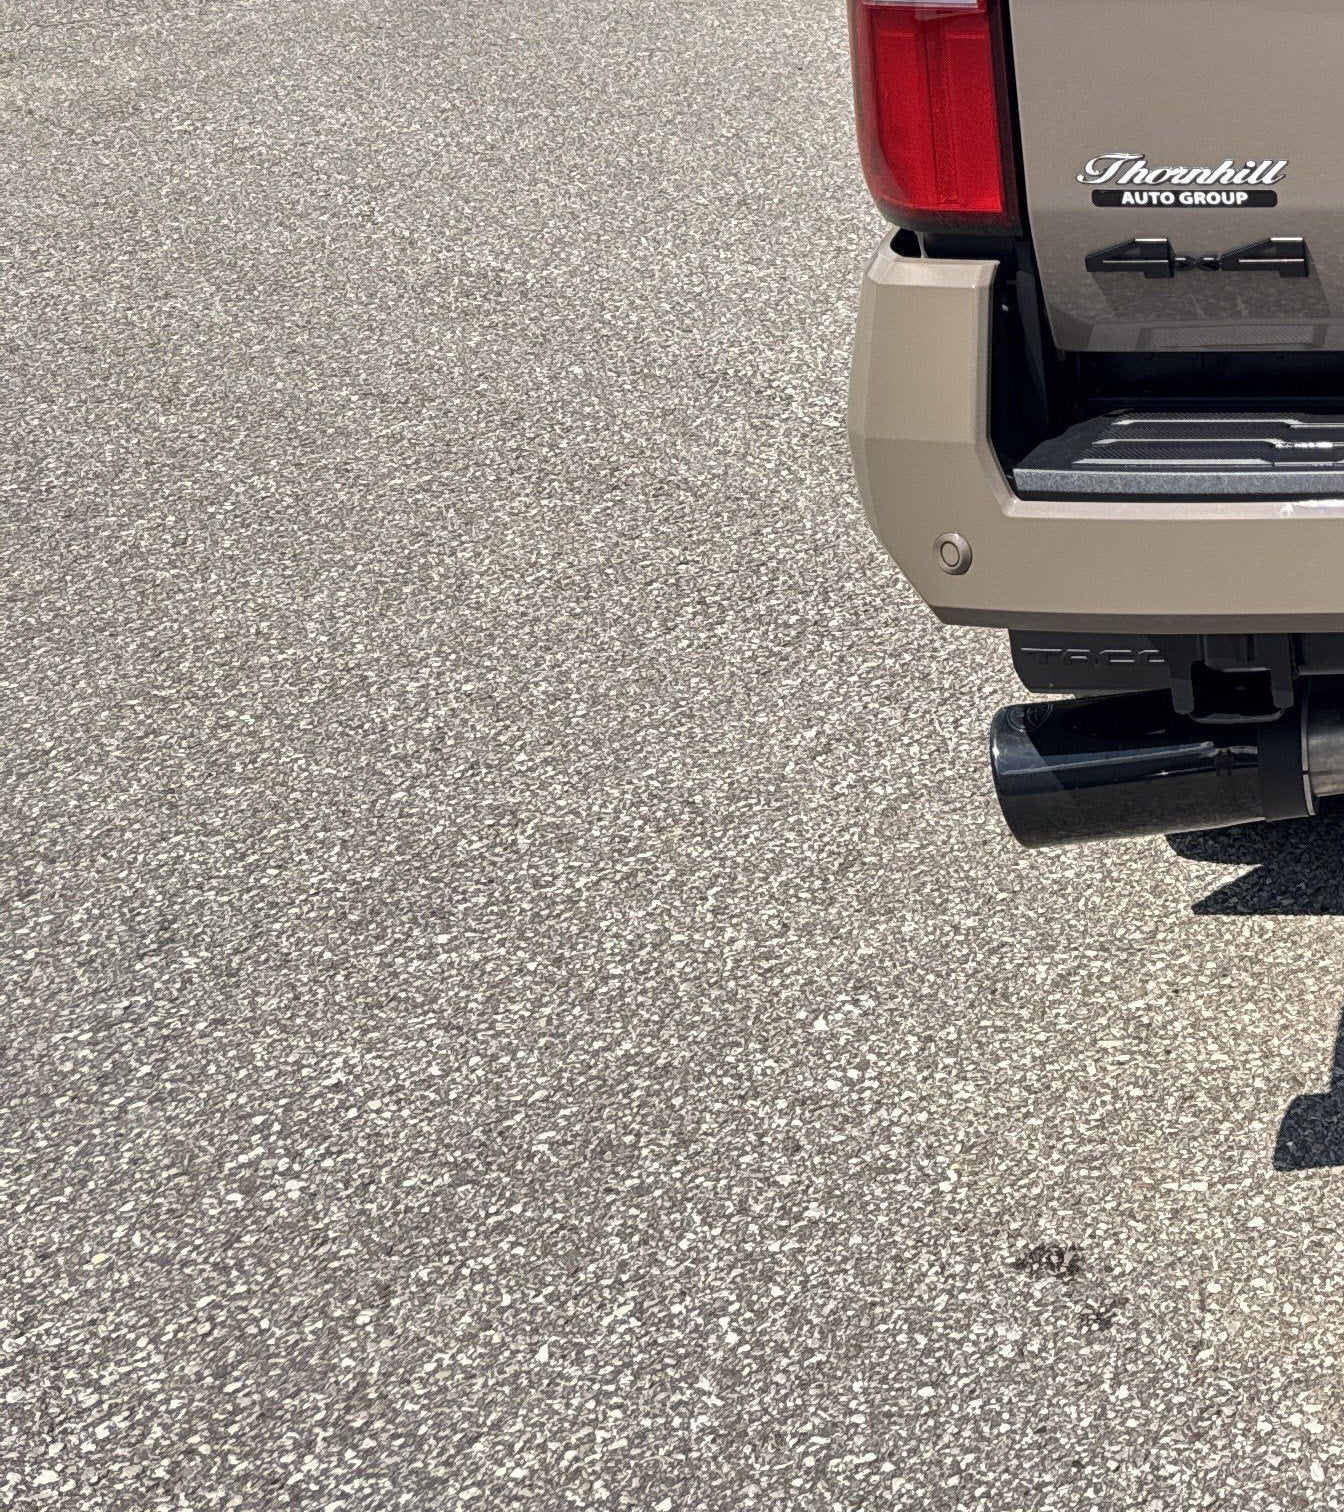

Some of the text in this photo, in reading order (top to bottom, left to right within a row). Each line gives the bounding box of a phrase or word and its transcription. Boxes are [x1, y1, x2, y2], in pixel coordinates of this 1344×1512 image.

[1076, 152, 1289, 186] Thornhill
[1121, 191, 1249, 206] AUTO GROUP
[1021, 646, 1169, 666] TACO
